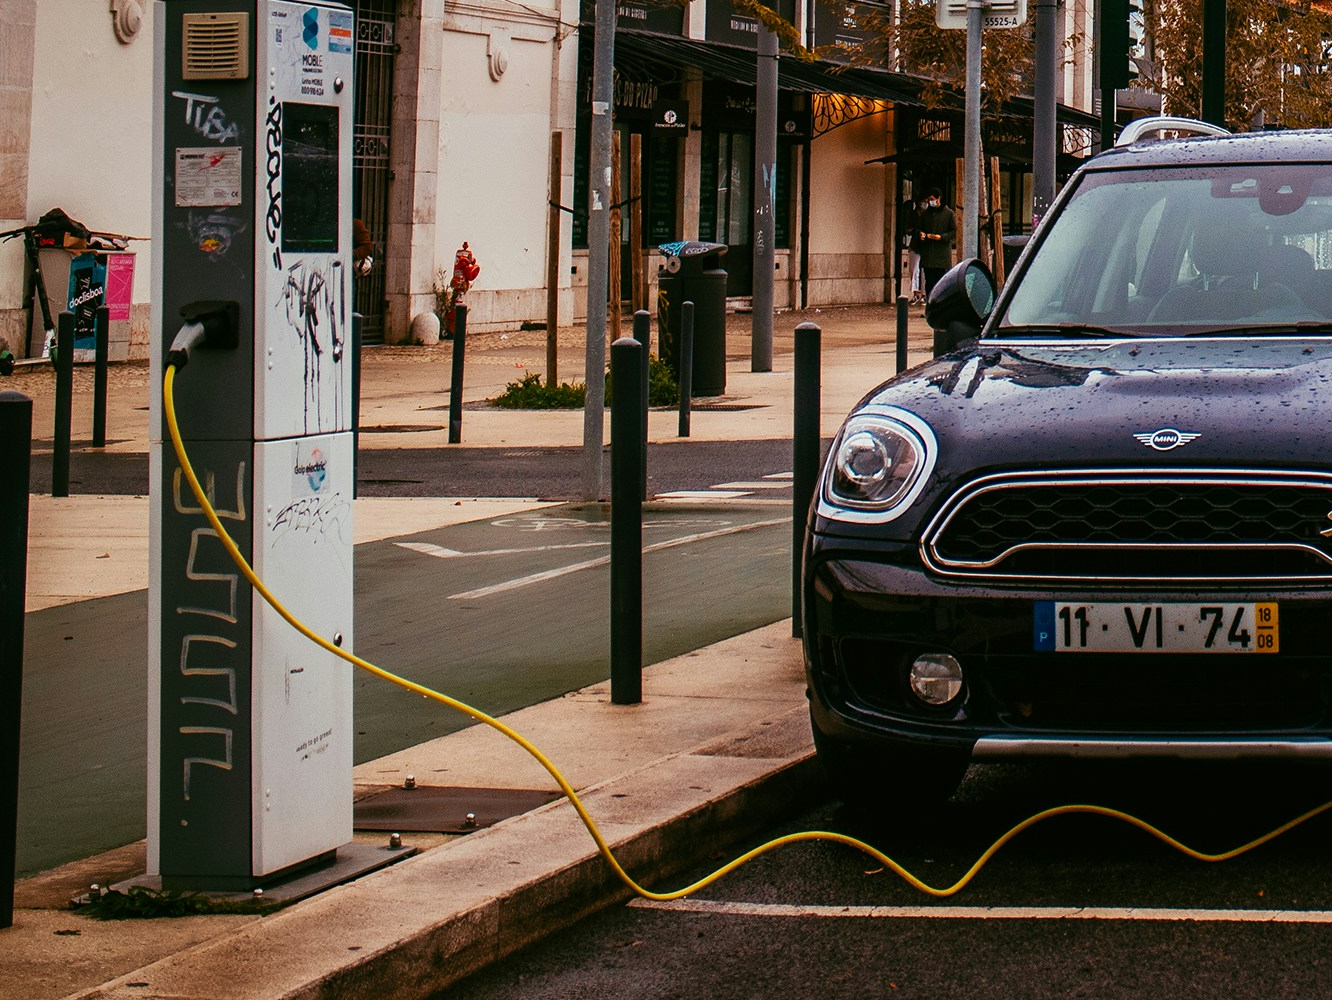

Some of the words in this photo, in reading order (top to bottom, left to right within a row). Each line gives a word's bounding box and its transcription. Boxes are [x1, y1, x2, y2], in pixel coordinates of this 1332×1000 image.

[69, 286, 104, 309] doclisboa
[1154, 435, 1177, 443] MINI
[1258, 607, 1271, 622] 18
[1257, 634, 1273, 649] 08
